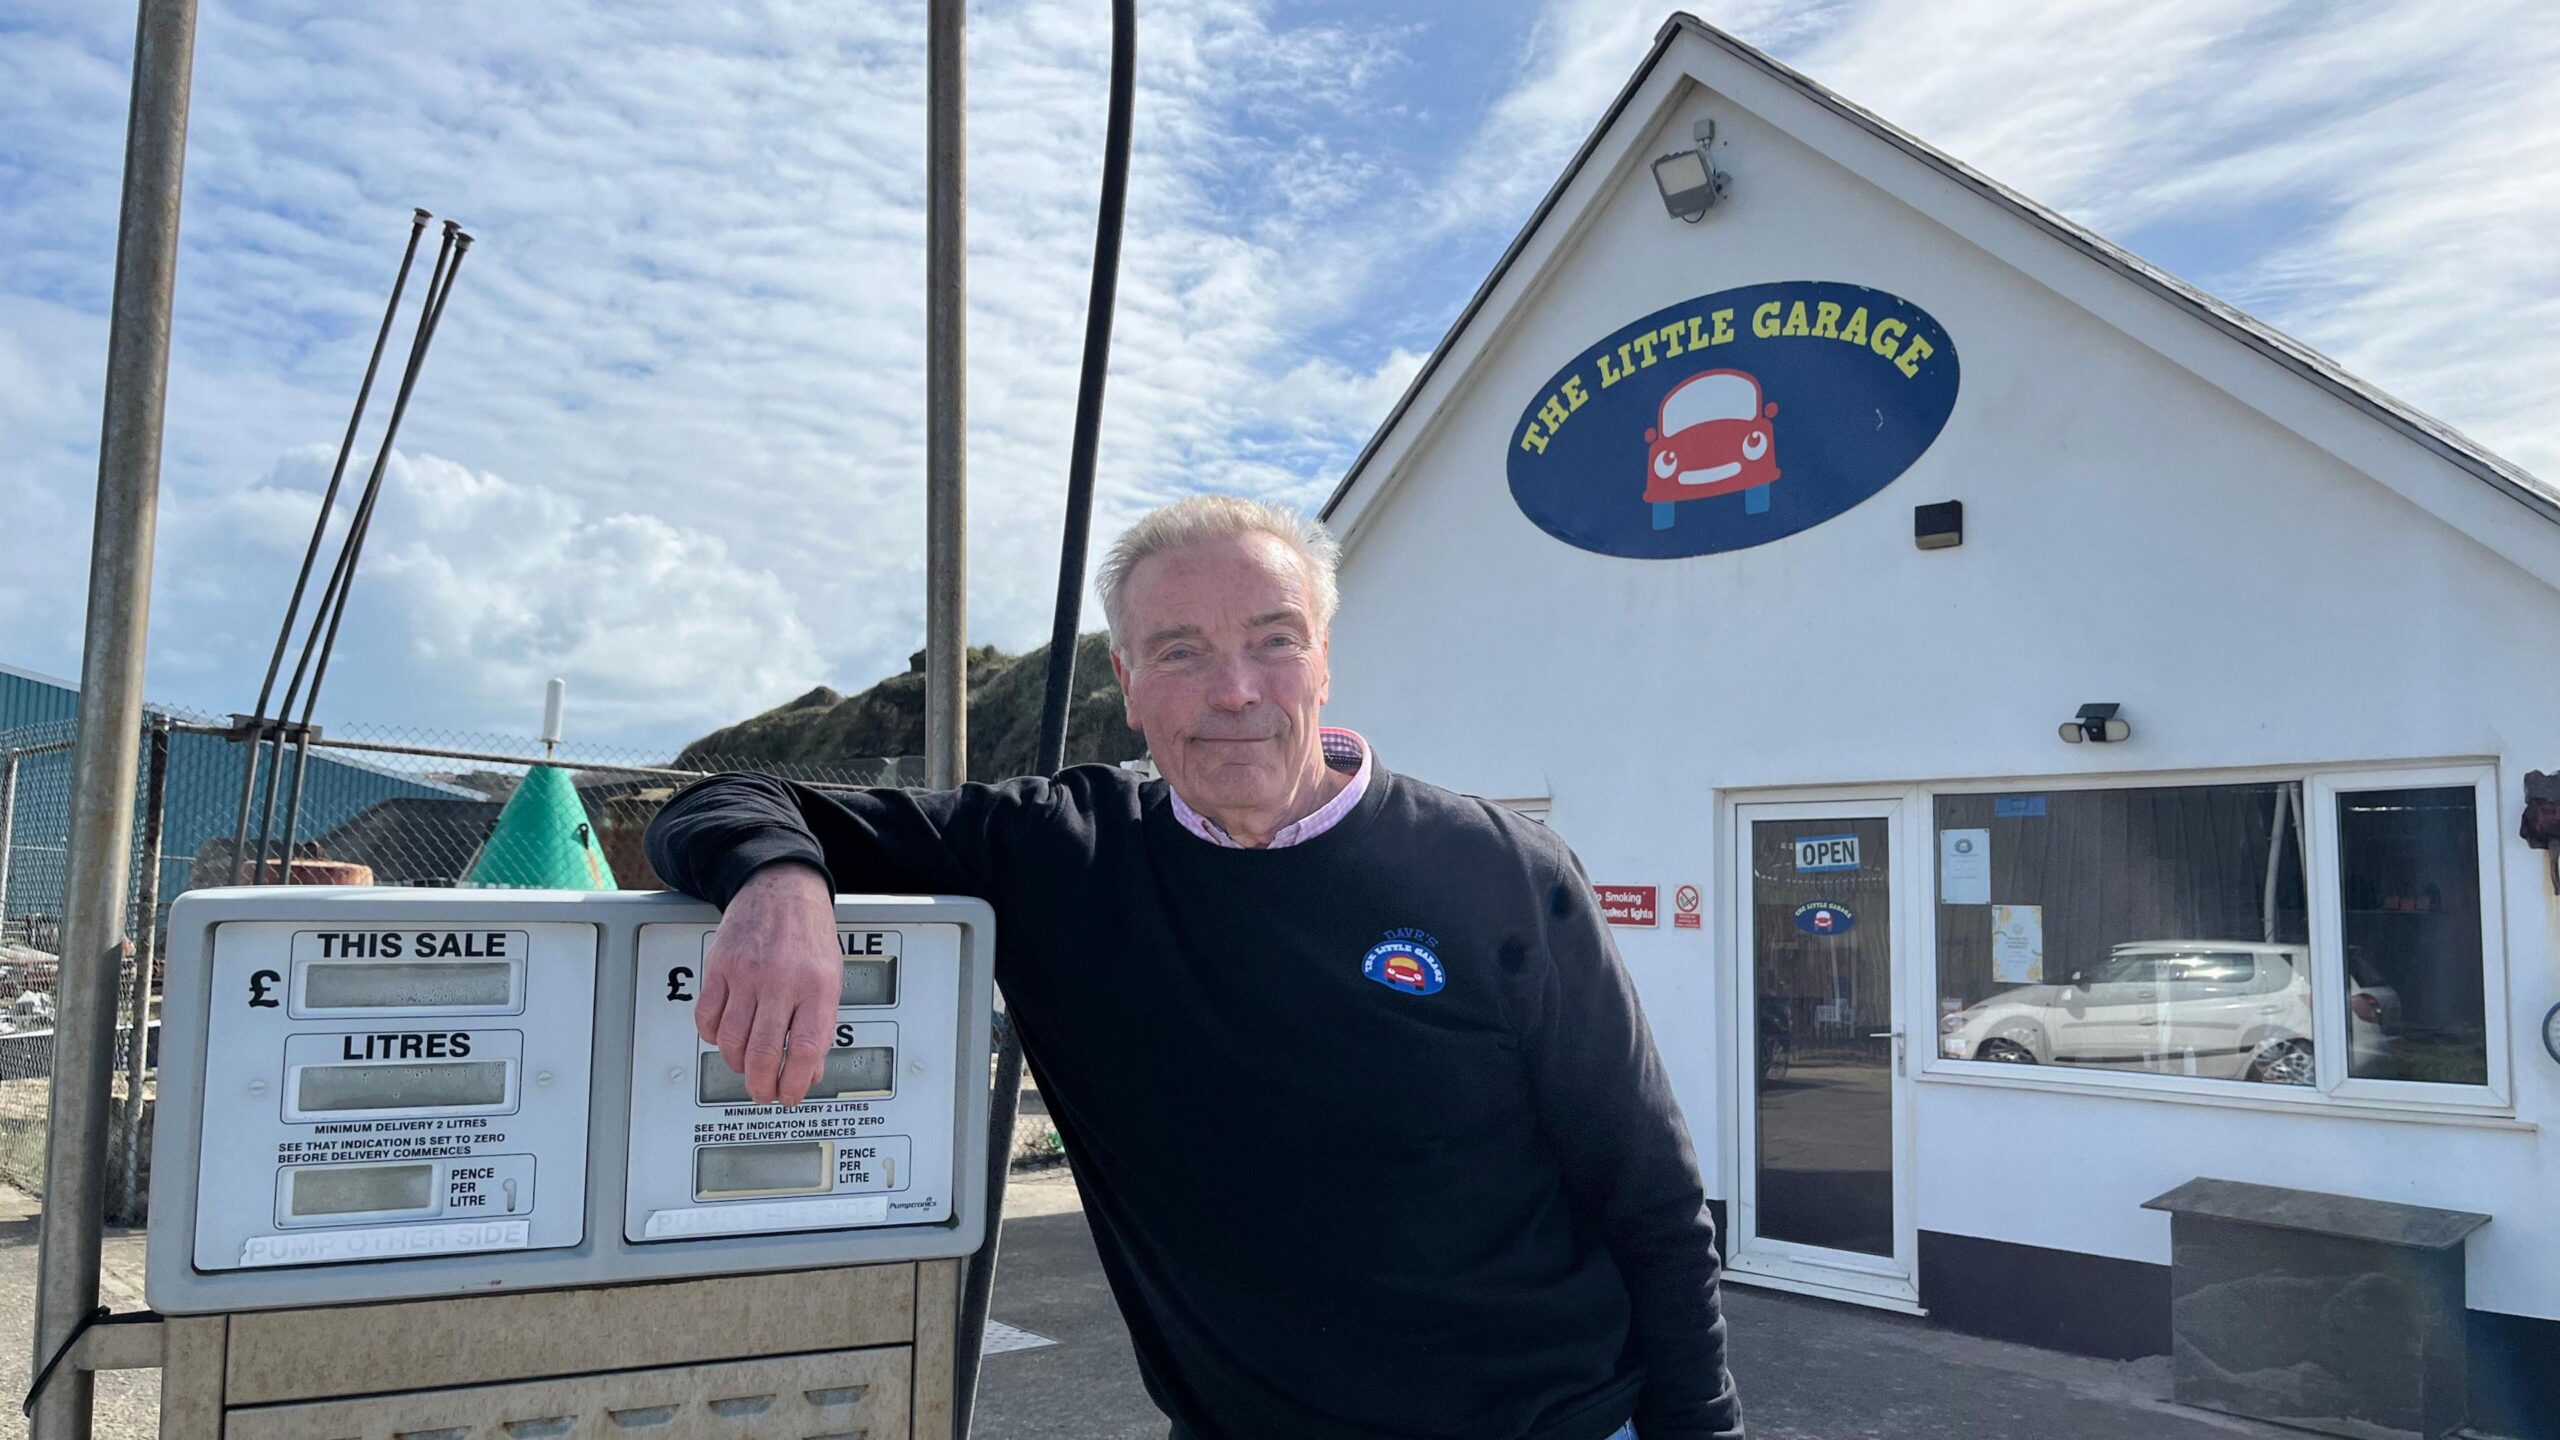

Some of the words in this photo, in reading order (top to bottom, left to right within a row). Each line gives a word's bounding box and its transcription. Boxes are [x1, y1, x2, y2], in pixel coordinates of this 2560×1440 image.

[1520, 374, 1589, 456] THE
[1596, 308, 1735, 389] LITTLE
[1752, 301, 1935, 380] GARAGE
[1802, 840, 1855, 866] OPEN
[1605, 891, 1642, 905] Smoking
[1630, 908, 1654, 920] lights
[1795, 905, 1806, 917] THE
[1807, 902, 1828, 911] LITTLE
[1828, 903, 1852, 919] GARAGE
[317, 933, 402, 958] THIS
[415, 932, 507, 957] SALE
[837, 932, 884, 956] LE
[1384, 927, 1439, 948] DAVE'S
[1364, 953, 1377, 973] THE
[1375, 944, 1412, 955] LITTLE
[1414, 948, 1443, 984] GARAGE
[249, 969, 282, 1008] £
[666, 966, 695, 1002] £
[342, 1032, 472, 1060] LITRES
[724, 1107, 772, 1117] MINIMUM
[775, 1105, 824, 1115] DELIVERY
[826, 1104, 833, 1113] 2
[835, 1103, 869, 1112] LITRES
[315, 1123, 372, 1135] MINIMUM
[376, 1121, 433, 1132] DELIVERY
[437, 1120, 444, 1130] 2
[447, 1118, 488, 1130] LITRES
[694, 1124, 715, 1133] SEE
[717, 1122, 743, 1131] THAT
[746, 1120, 806, 1130] INDICATION
[808, 1119, 818, 1128] IS
[821, 1118, 839, 1127] SET
[842, 1117, 856, 1126] TO
[858, 1116, 885, 1125] ZERO
[279, 1142, 303, 1152] SEE
[306, 1140, 338, 1151] THAT
[341, 1138, 411, 1149] INDICATION
[415, 1136, 426, 1146] IS
[430, 1135, 451, 1146] SET
[455, 1135, 471, 1144] TO
[474, 1133, 506, 1143] ZERO
[694, 1133, 736, 1143] BEFORE
[738, 1130, 788, 1141] DELIVERY
[790, 1127, 856, 1139] COMMENCES
[278, 1152, 328, 1164] BEFORE
[331, 1150, 389, 1161] DELIVERY
[393, 1146, 472, 1158] COMMENCES
[839, 1148, 877, 1159] PENCE
[451, 1168, 495, 1181] PENCE
[839, 1161, 861, 1172] PER
[839, 1173, 870, 1184] LITRE
[450, 1182, 476, 1194] PER
[449, 1195, 486, 1208] LITRE
[888, 1200, 938, 1210] Pumptronics
[248, 1236, 335, 1263] PUMP
[346, 1228, 446, 1253] OTHER
[456, 1224, 521, 1246] SIDE
